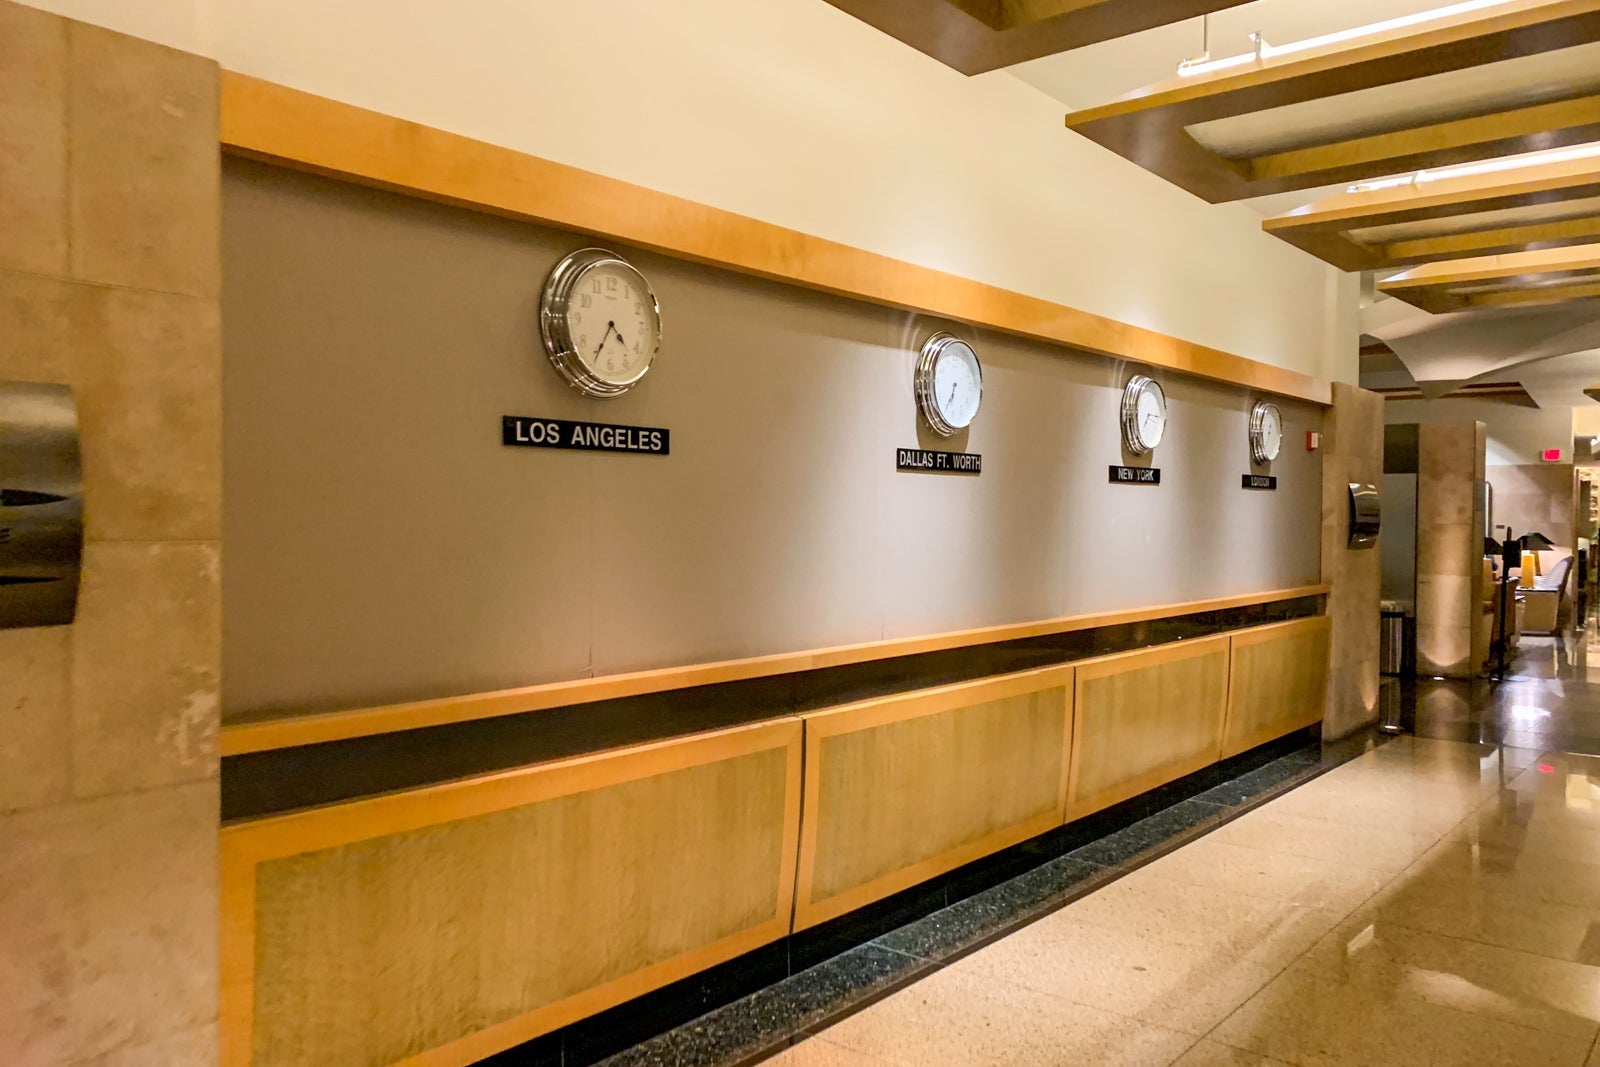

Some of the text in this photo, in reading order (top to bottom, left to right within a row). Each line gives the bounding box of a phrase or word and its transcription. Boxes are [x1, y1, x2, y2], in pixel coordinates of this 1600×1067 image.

[592, 279, 601, 293] 11
[606, 277, 618, 291] 12
[580, 293, 592, 308] 10
[634, 302, 642, 315] 2
[574, 312, 582, 326] 9
[639, 321, 645, 335] 3
[579, 334, 587, 348] 8
[633, 341, 640, 355] 4
[607, 357, 614, 371] 6
[622, 353, 629, 368] 5
[516, 421, 662, 450] LOS ANGELES
[900, 450, 981, 470] DALLAS FT. WORTH
[1118, 467, 1154, 481] NEW YORK
